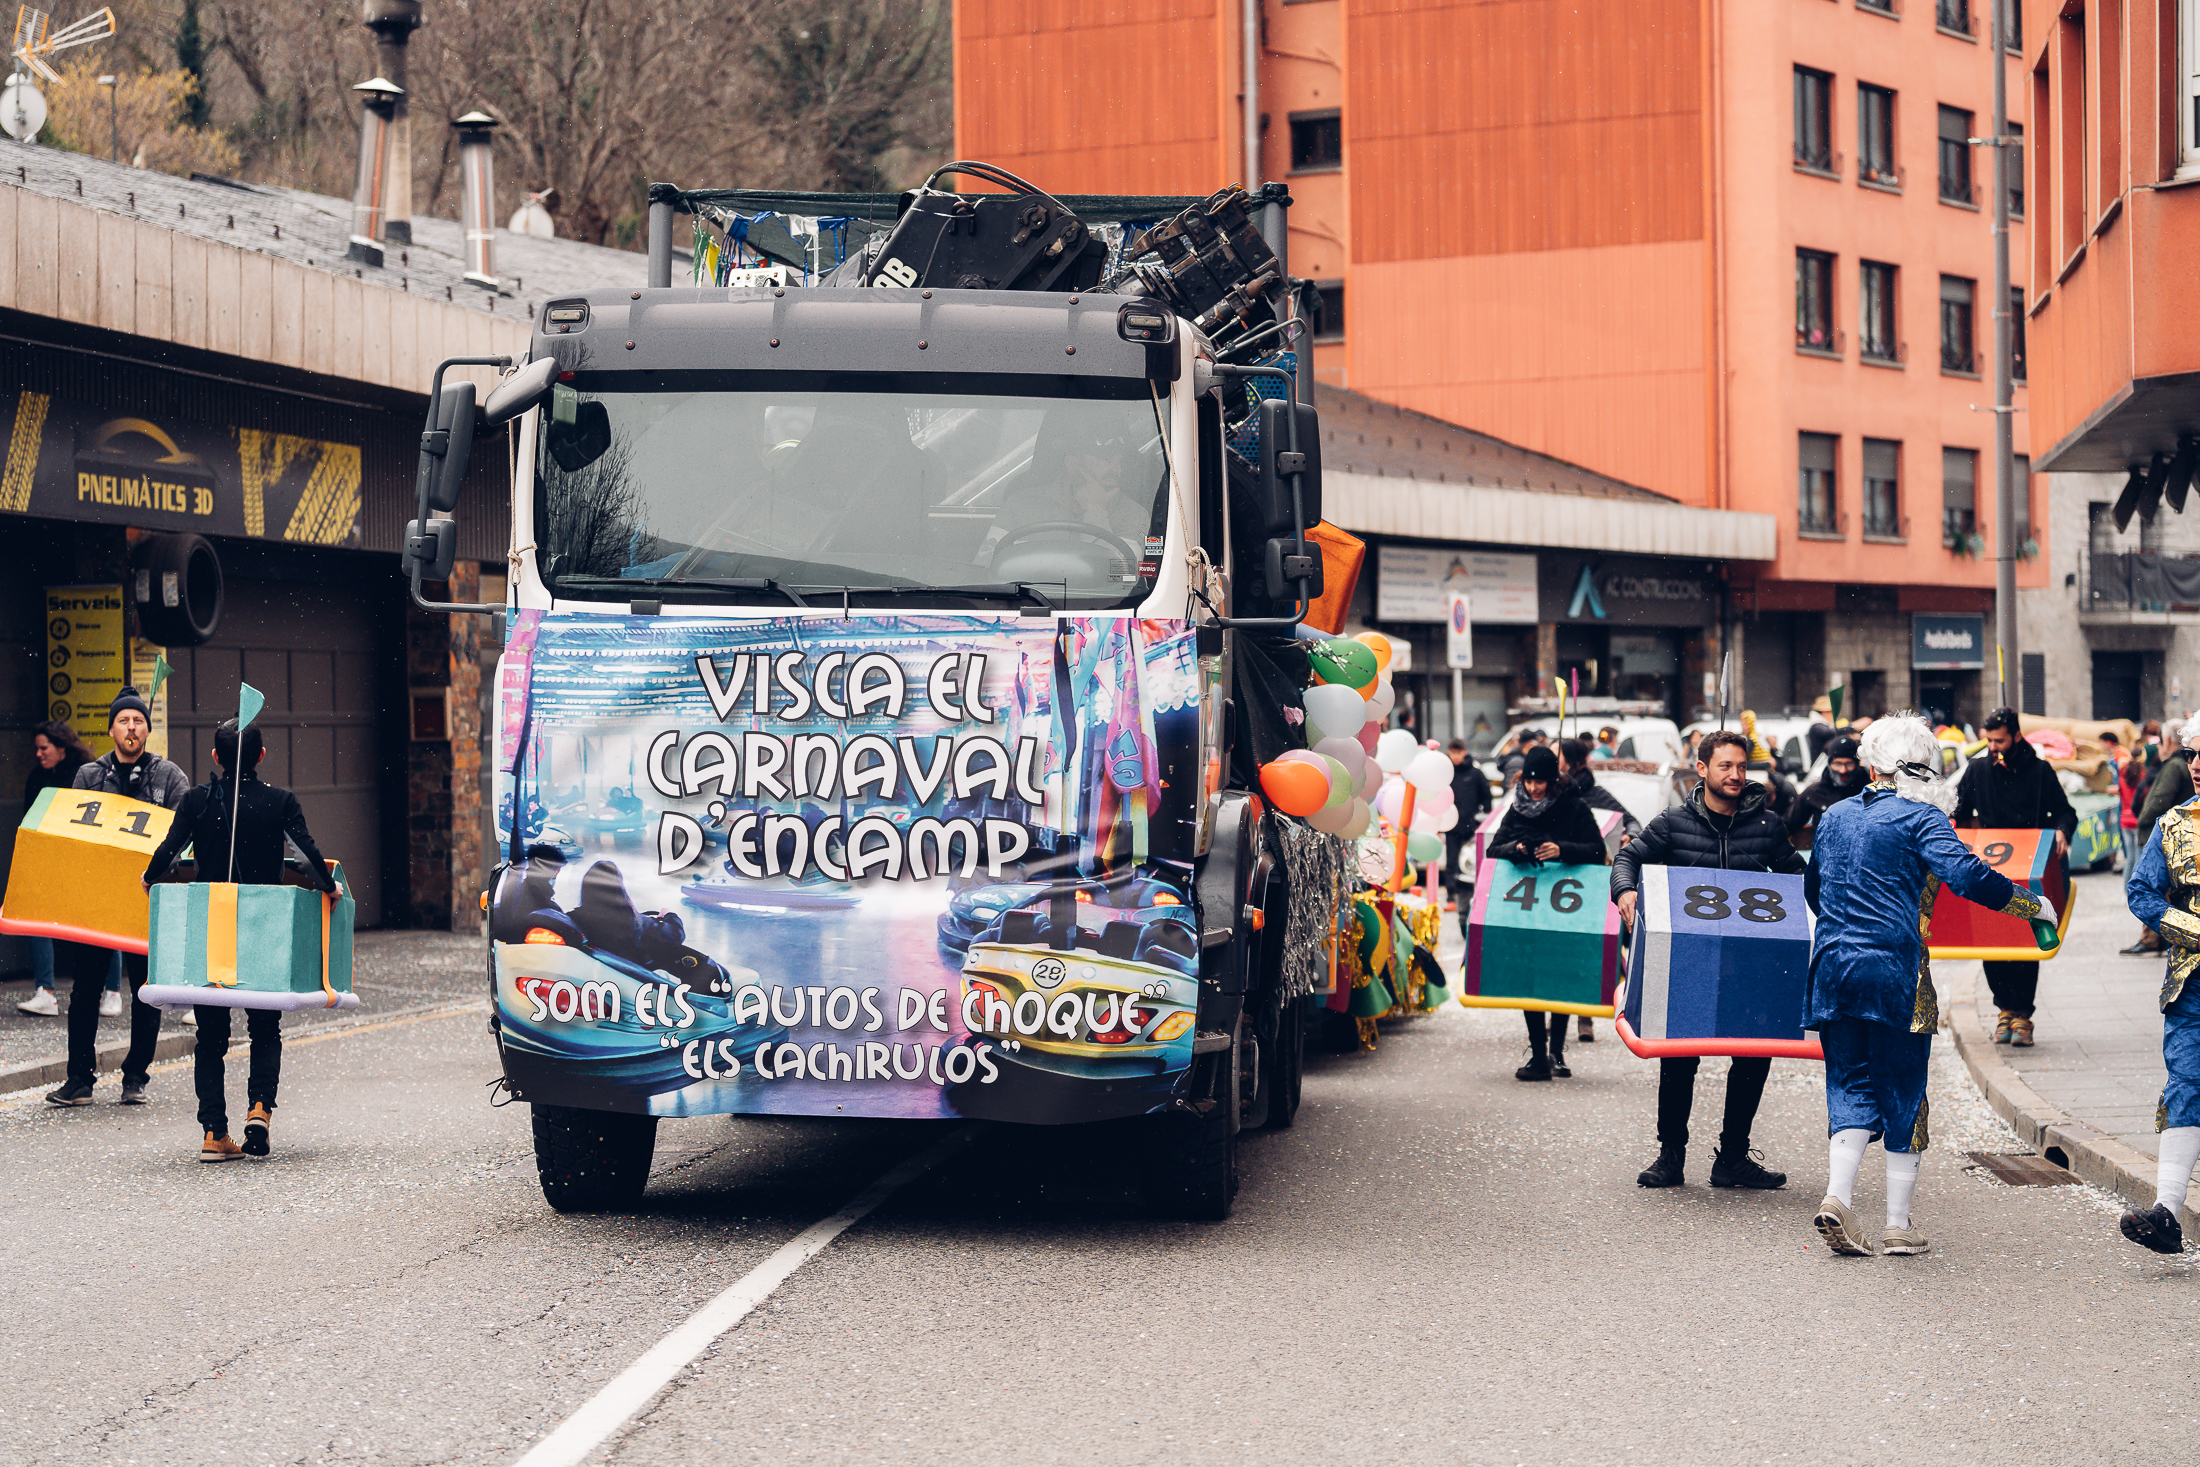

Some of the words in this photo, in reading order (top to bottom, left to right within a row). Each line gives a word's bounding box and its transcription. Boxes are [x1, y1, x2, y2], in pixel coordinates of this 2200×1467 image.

[78, 472, 187, 513] PNEUMÀTICS
[193, 486, 214, 516] 3D
[48, 595, 121, 611] Serveis
[695, 650, 907, 723] VISCA
[927, 651, 995, 724] EL
[647, 729, 1046, 808] CARNAVAL
[657, 800, 1030, 883] D'ENCAMP
[1503, 876, 1585, 914] 46
[1683, 884, 1788, 923] 88
[1035, 963, 1062, 980] 28
[525, 978, 622, 1024] SOM
[634, 981, 696, 1030] ELS
[897, 986, 950, 1033] DE
